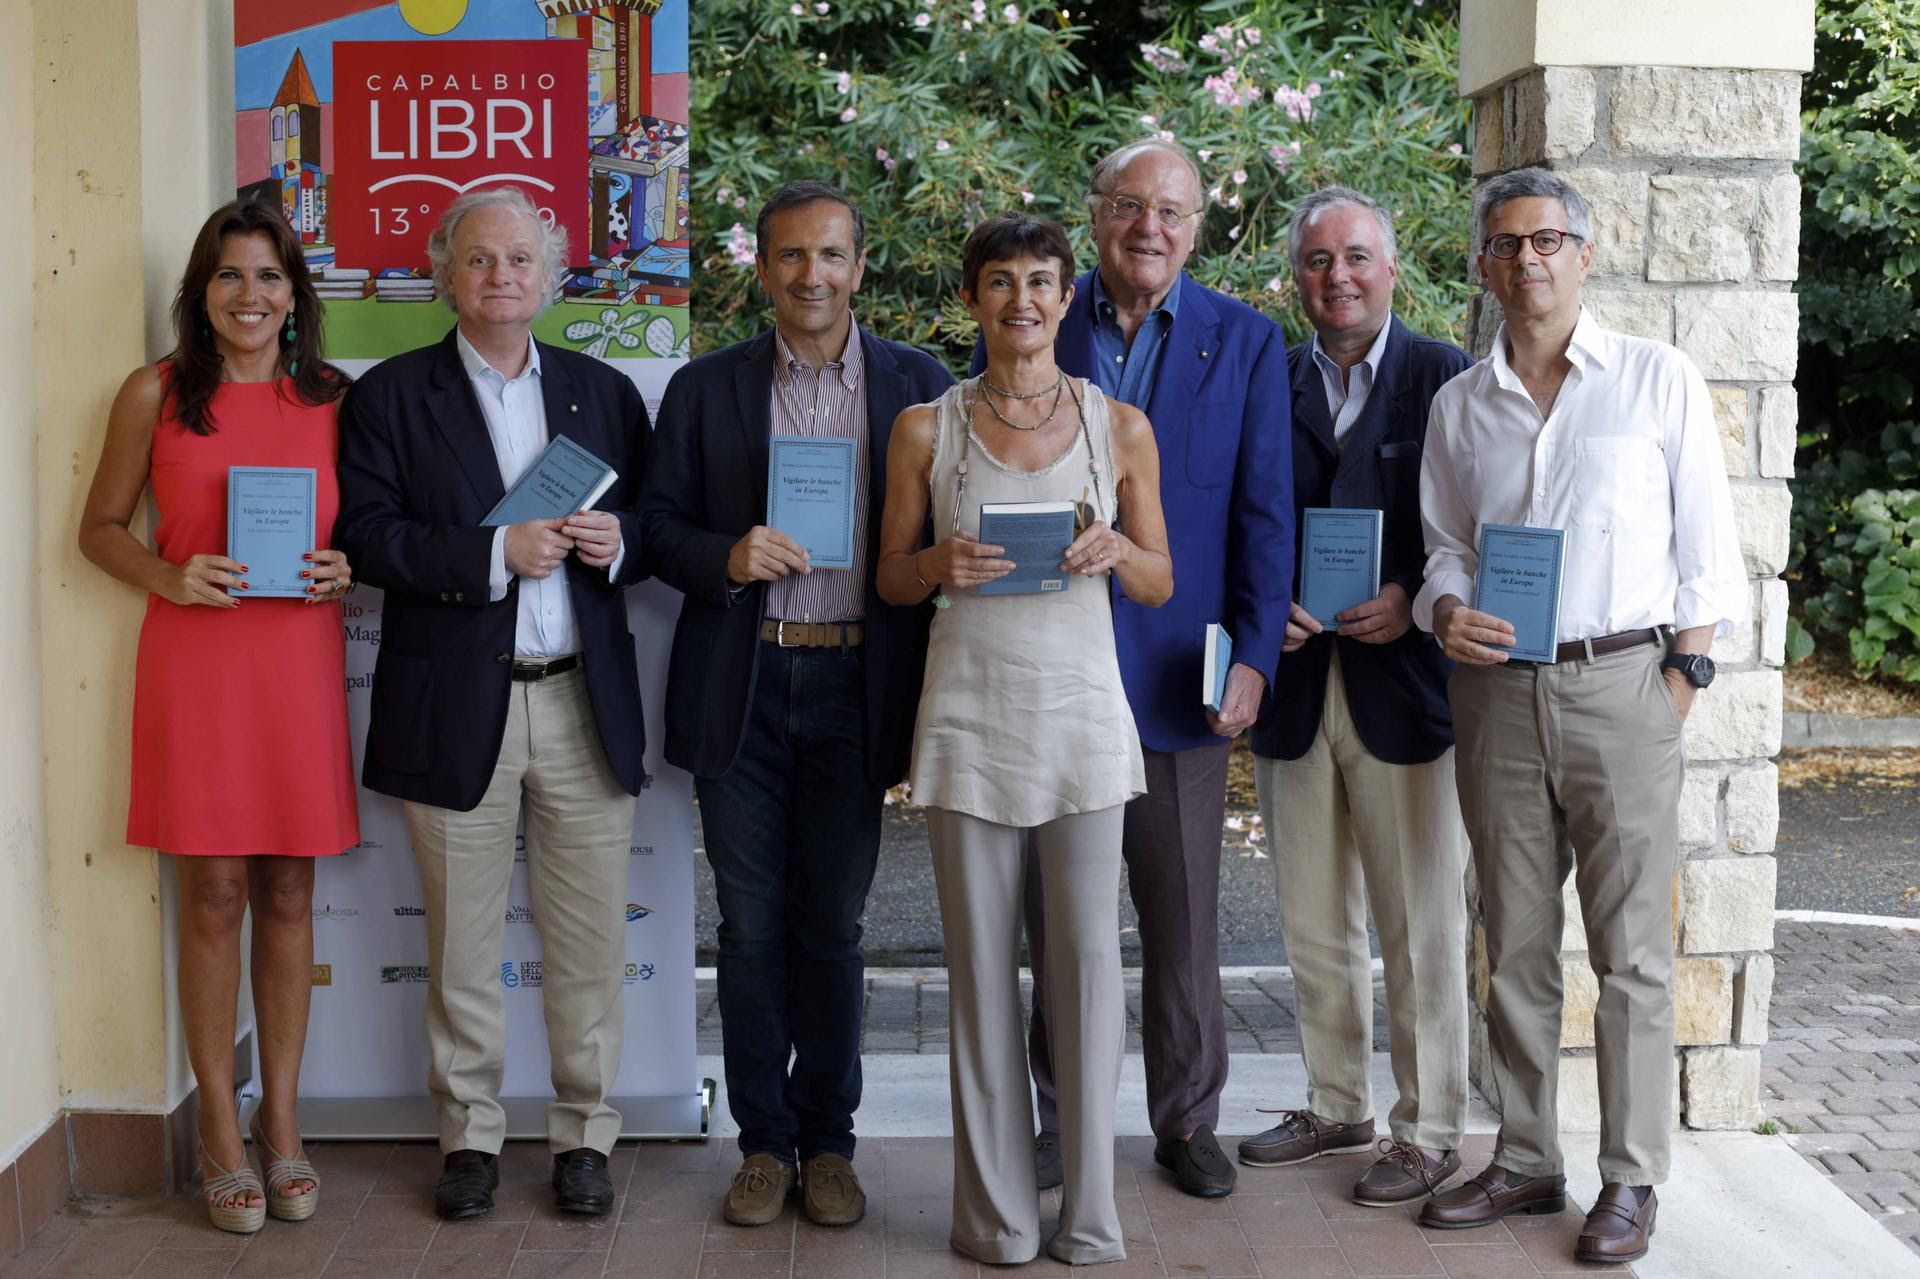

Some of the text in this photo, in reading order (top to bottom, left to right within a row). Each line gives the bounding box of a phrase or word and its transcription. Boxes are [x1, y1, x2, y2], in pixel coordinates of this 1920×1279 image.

[619, 22, 627, 113] CAPALBIO LIBRI
[367, 73, 555, 91] CAPALBIO
[370, 98, 552, 159] LIBRI
[304, 189, 312, 231] Capalbio
[783, 476, 807, 484] Vigilare
[817, 477, 841, 485] banche
[804, 487, 829, 496] Europa
[243, 507, 268, 515] Vigilare
[264, 517, 289, 525] Europa
[1314, 546, 1336, 555] Vigilare
[1344, 548, 1367, 556] banche
[1331, 556, 1354, 565] Europa
[1490, 566, 1547, 579] Vigilare le banche
[1509, 578, 1534, 587] Europa
